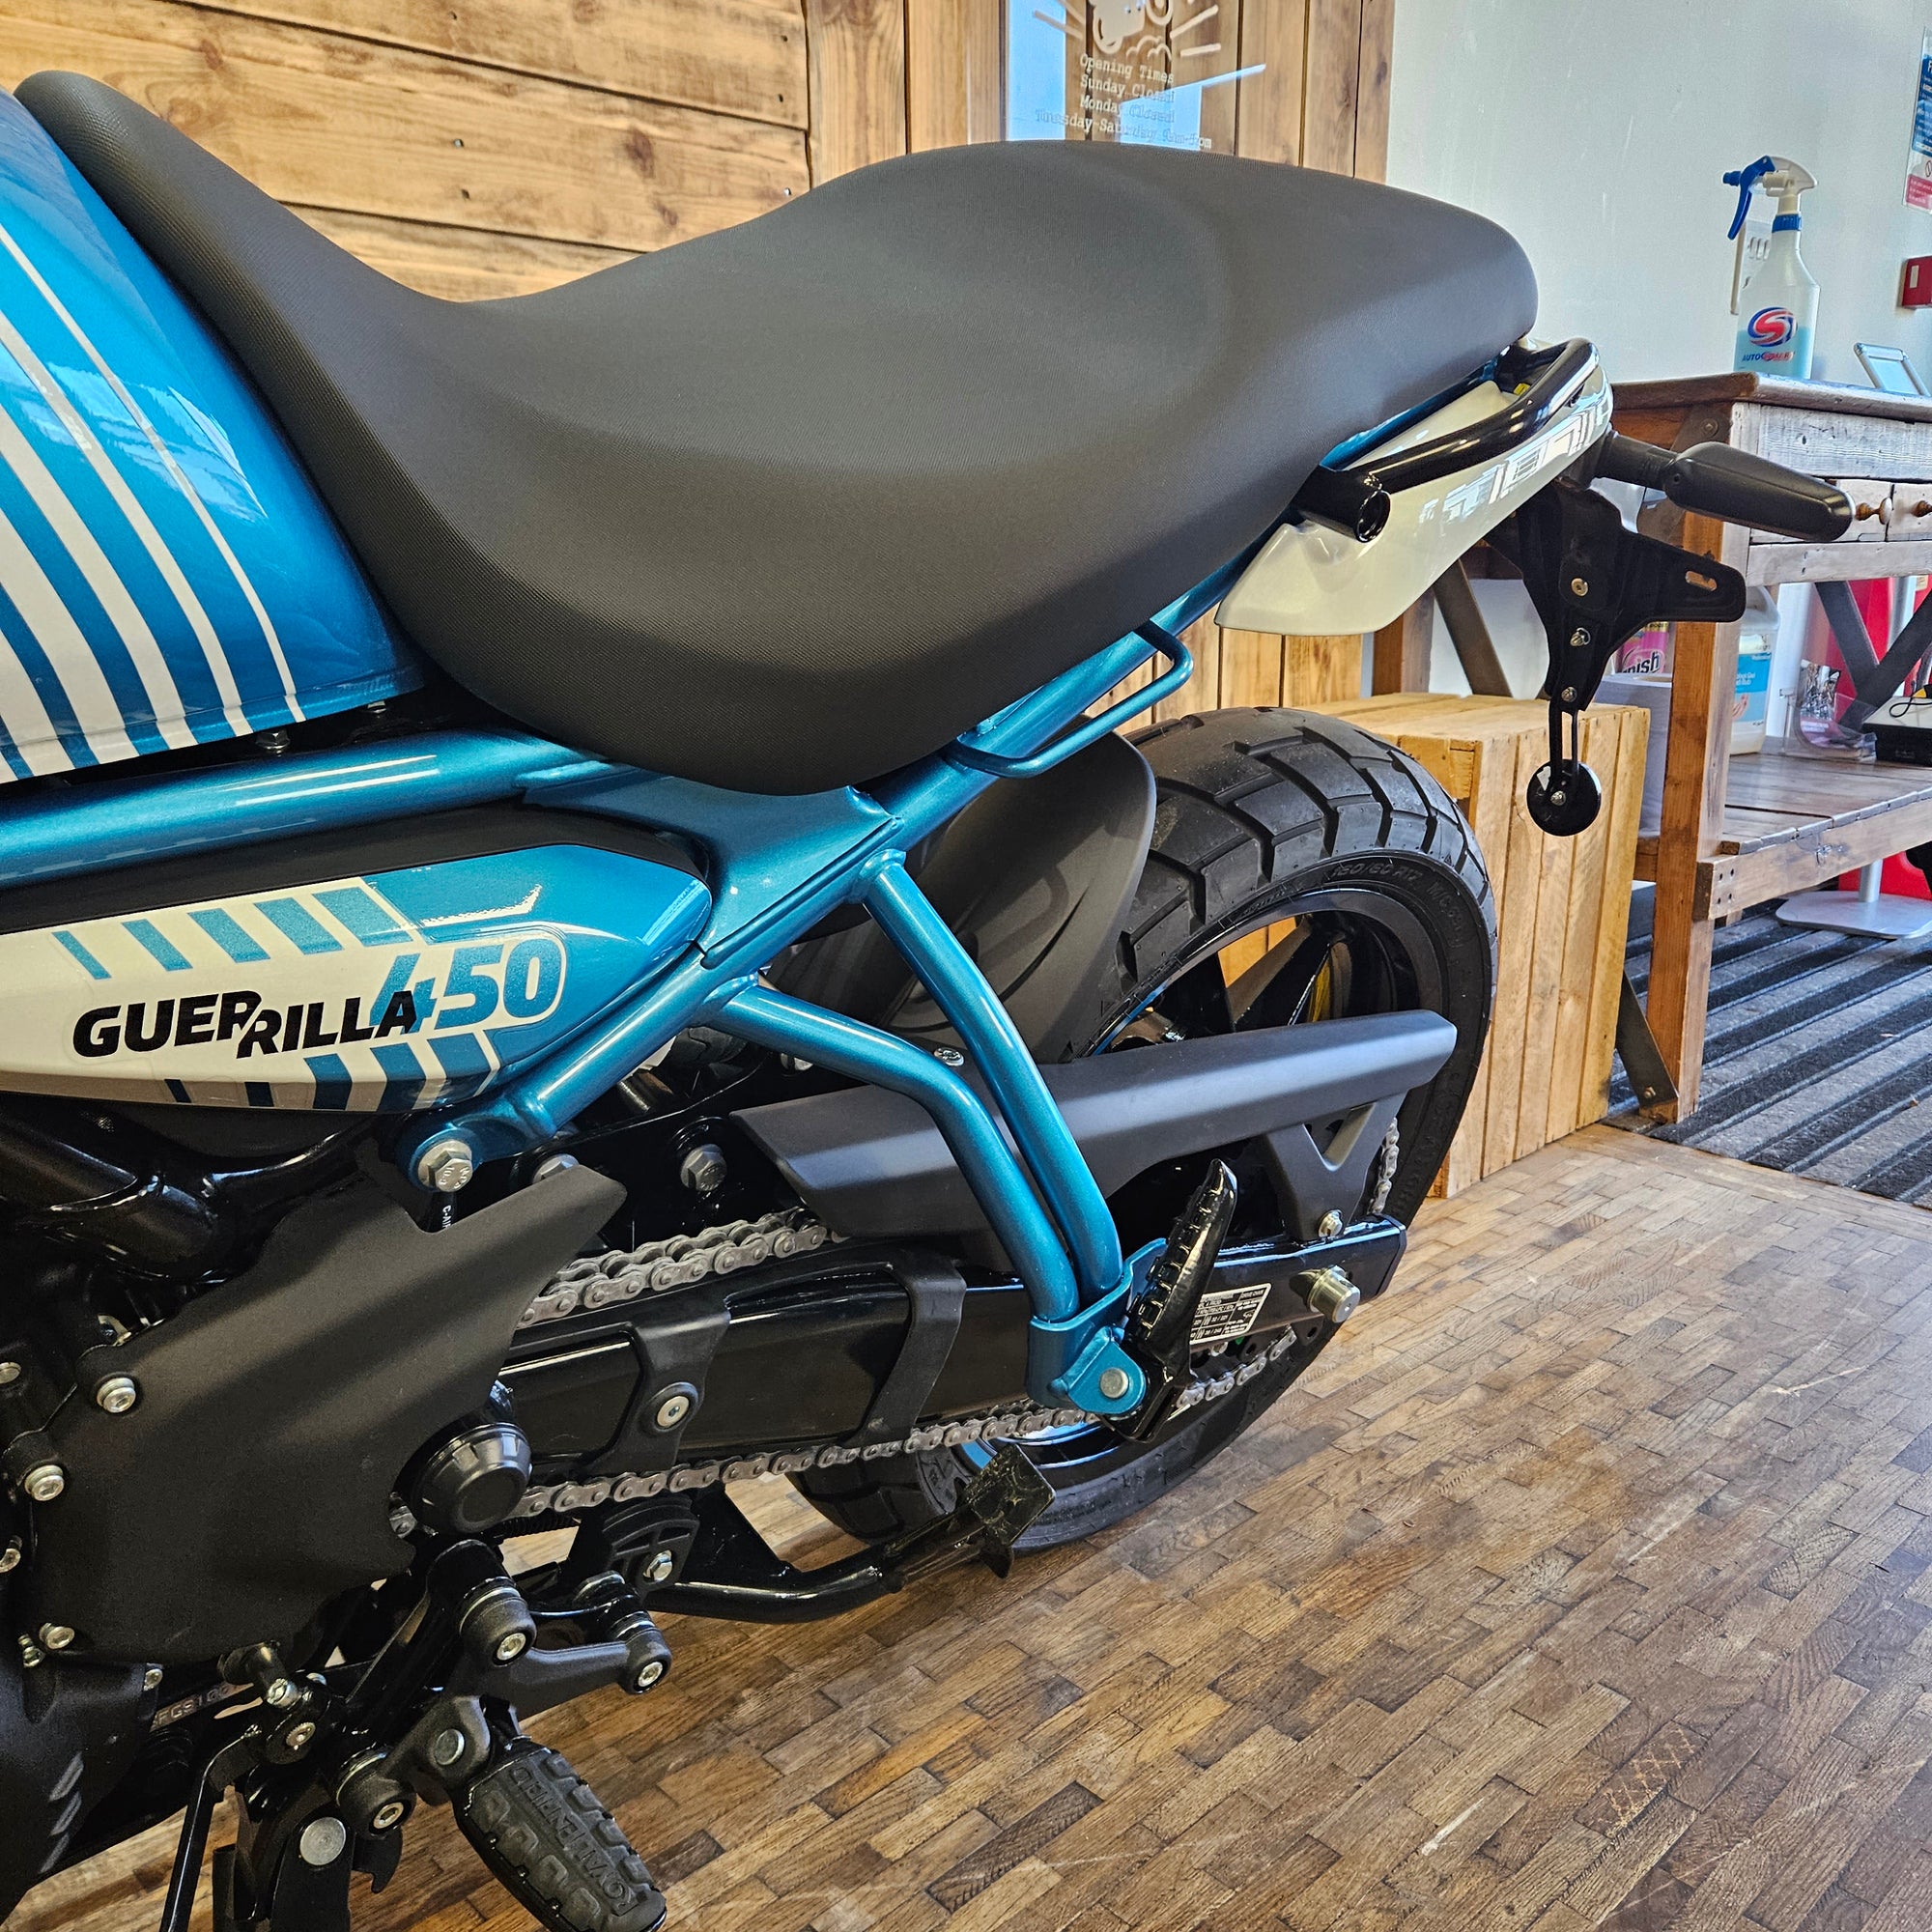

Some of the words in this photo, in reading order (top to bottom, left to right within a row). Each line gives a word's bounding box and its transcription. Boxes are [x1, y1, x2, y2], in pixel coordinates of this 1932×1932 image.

[1080, 53, 1133, 79] Opening
[1140, 65, 1175, 83] Times
[1080, 73, 1125, 99] Sunday
[1080, 95, 1124, 117] Monday
[1129, 103, 1175, 123] Closed
[72, 990, 417, 1059] GUERRILLA
[369, 938, 561, 1035] 450
